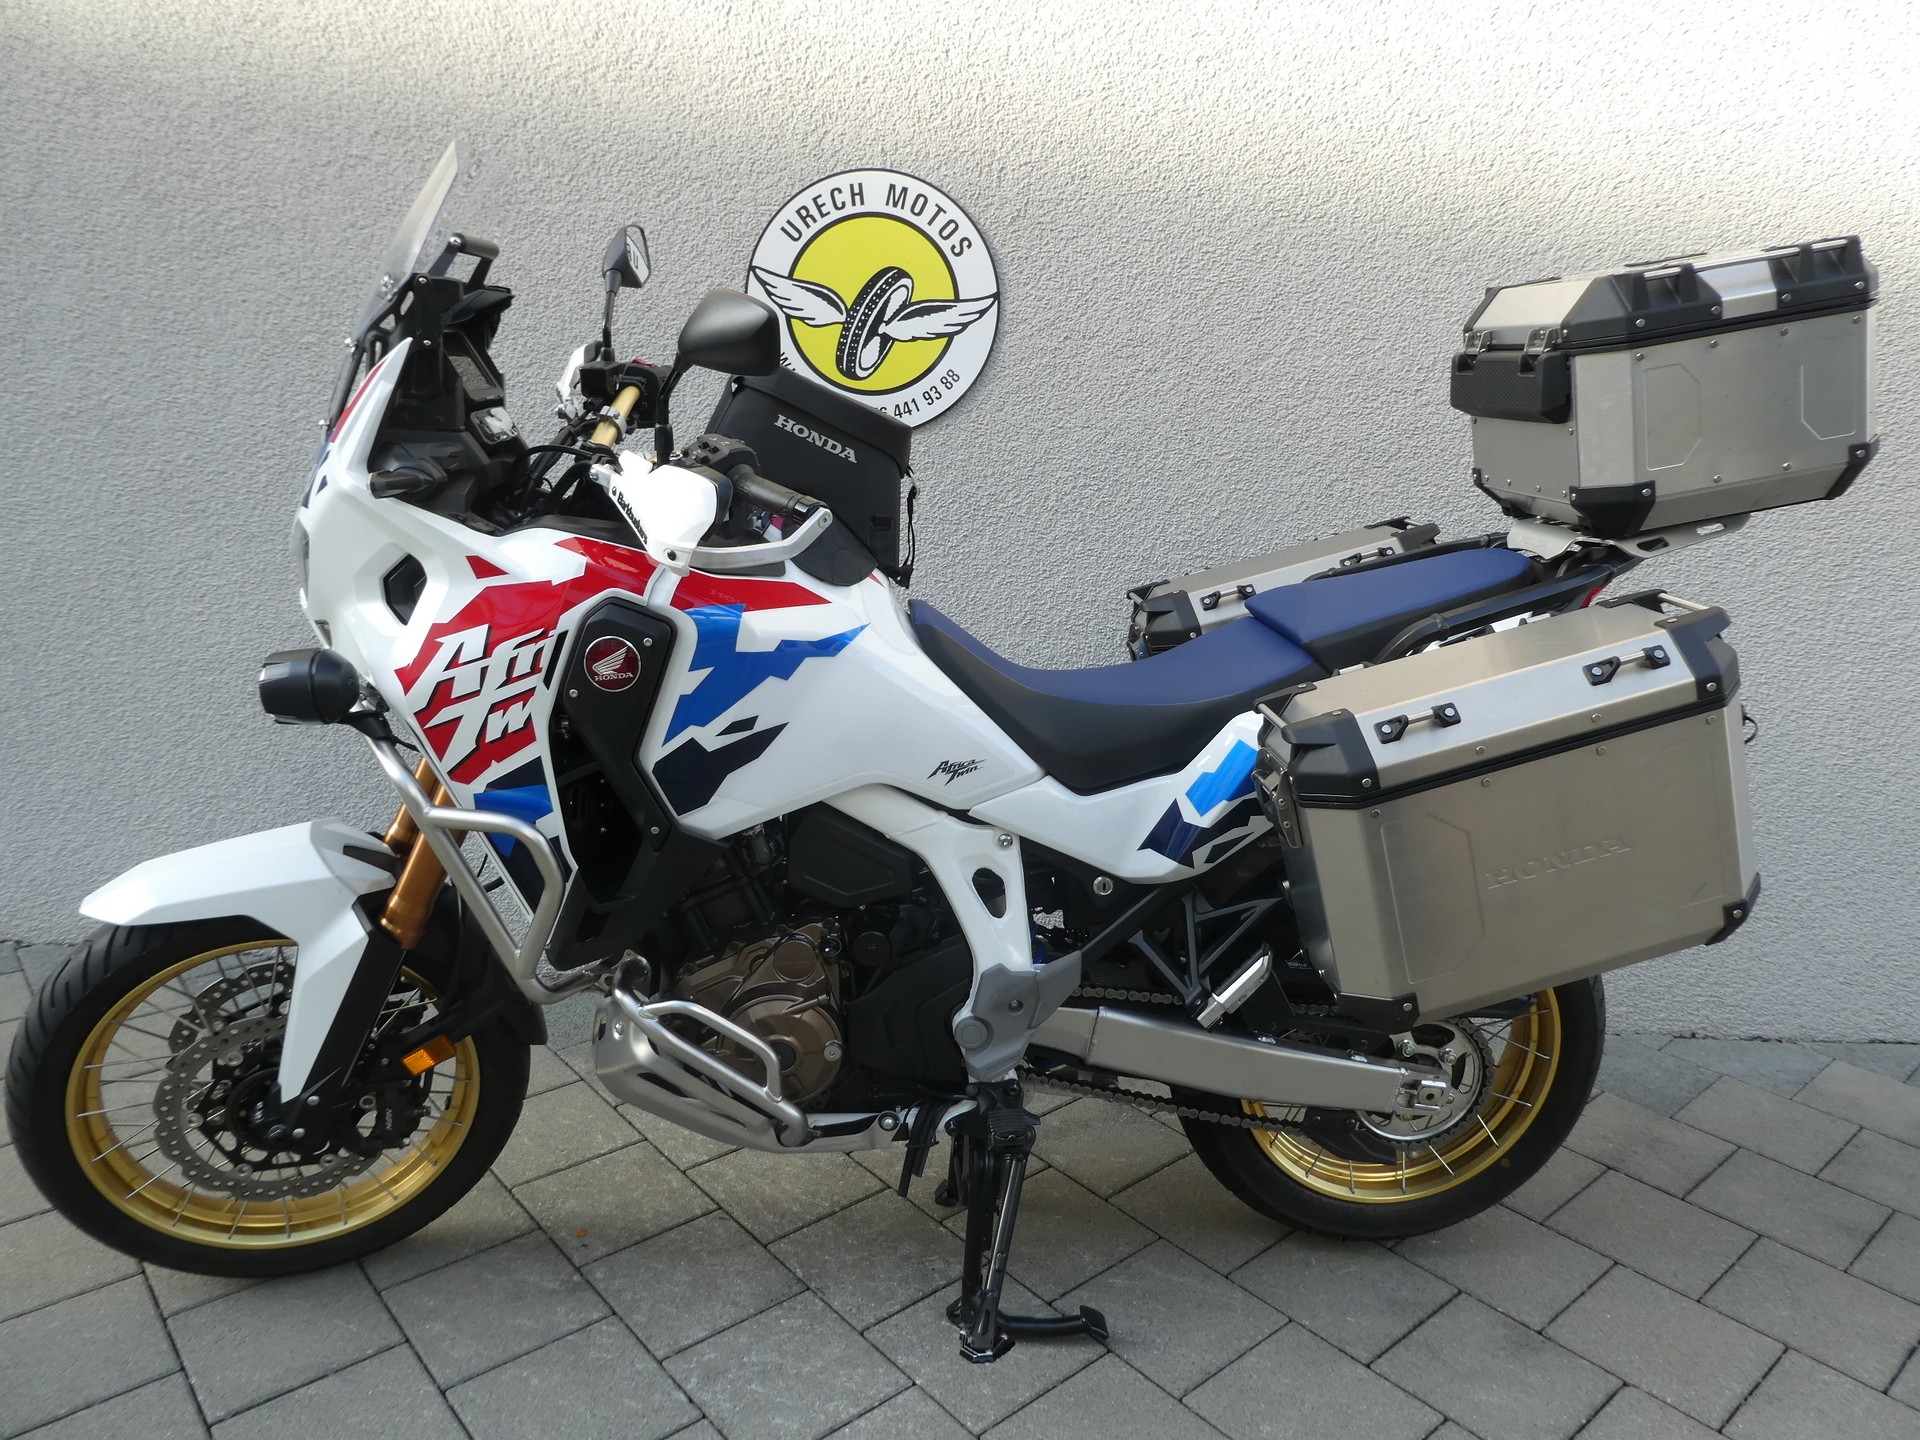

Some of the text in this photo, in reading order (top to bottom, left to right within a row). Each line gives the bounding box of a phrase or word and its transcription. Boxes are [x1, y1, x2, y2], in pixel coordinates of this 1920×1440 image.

[780, 182, 973, 257] URECH MOTOS
[893, 369, 961, 419] 441 93 88
[774, 413, 858, 464] HONDA
[594, 672, 634, 682] HONDA
[926, 759, 987, 780] Africa
[1485, 835, 1632, 890] HONDA
